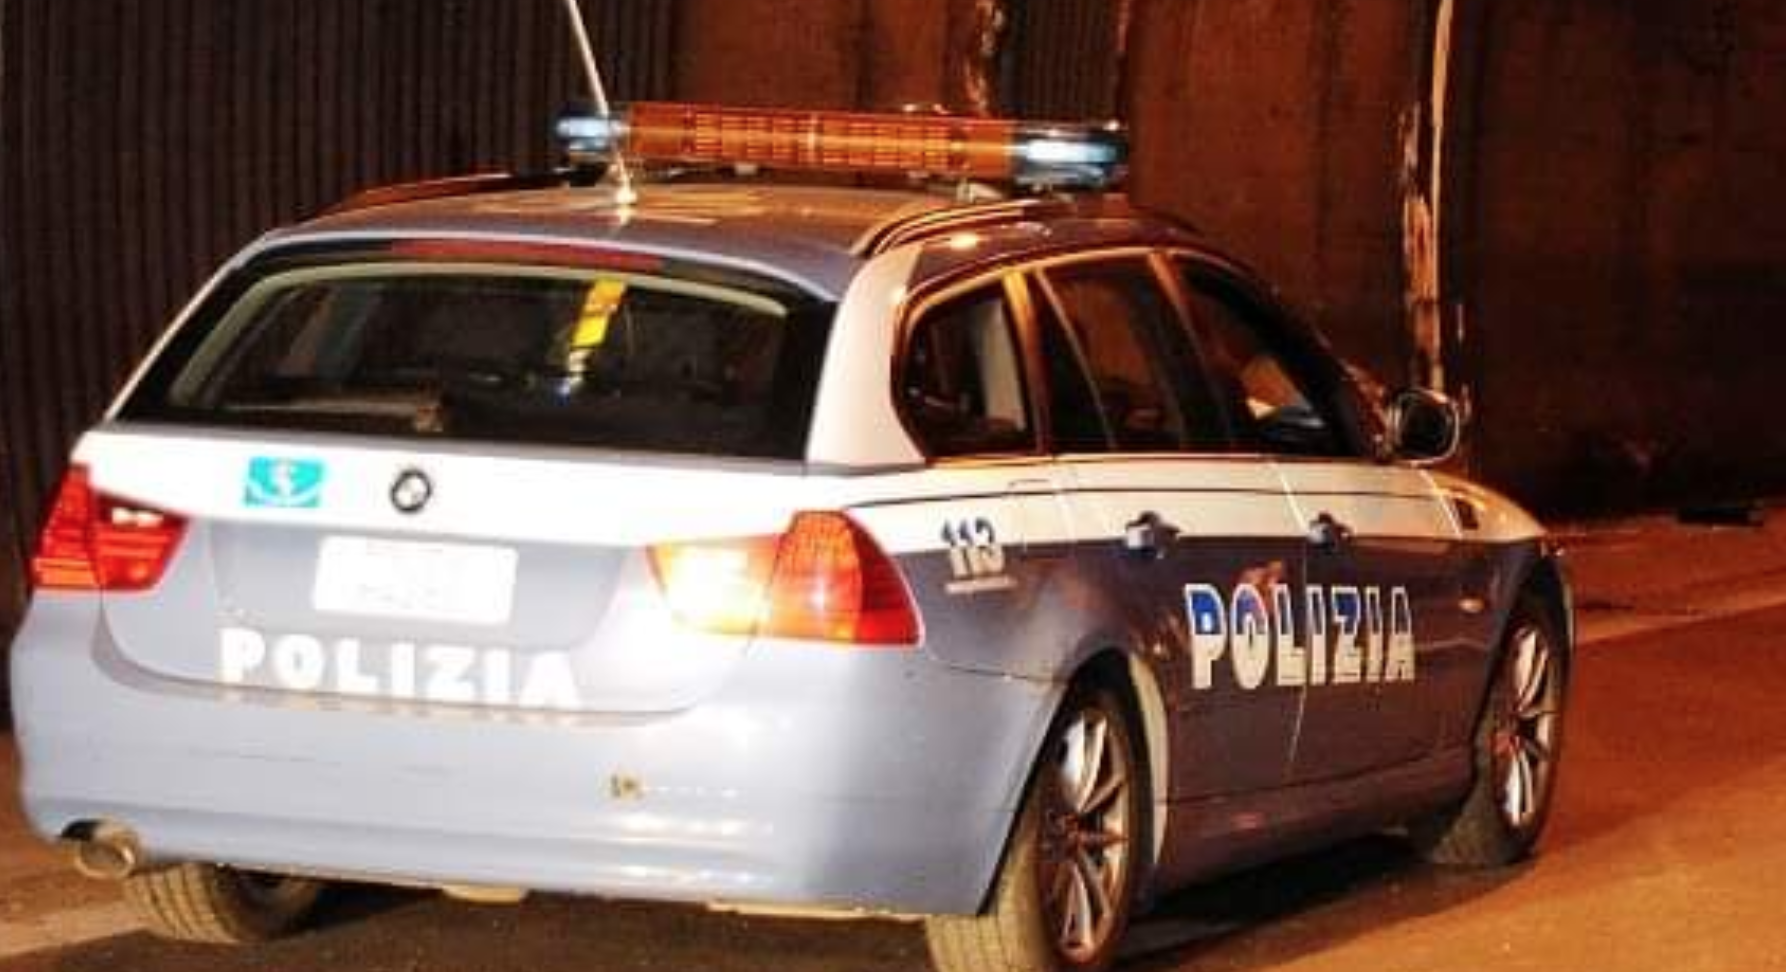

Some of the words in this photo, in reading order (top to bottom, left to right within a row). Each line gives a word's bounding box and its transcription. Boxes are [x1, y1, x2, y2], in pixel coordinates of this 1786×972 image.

[941, 517, 1005, 580] 113
[219, 627, 582, 709] POLIZIA
[1184, 583, 1415, 690] POLIZIA
